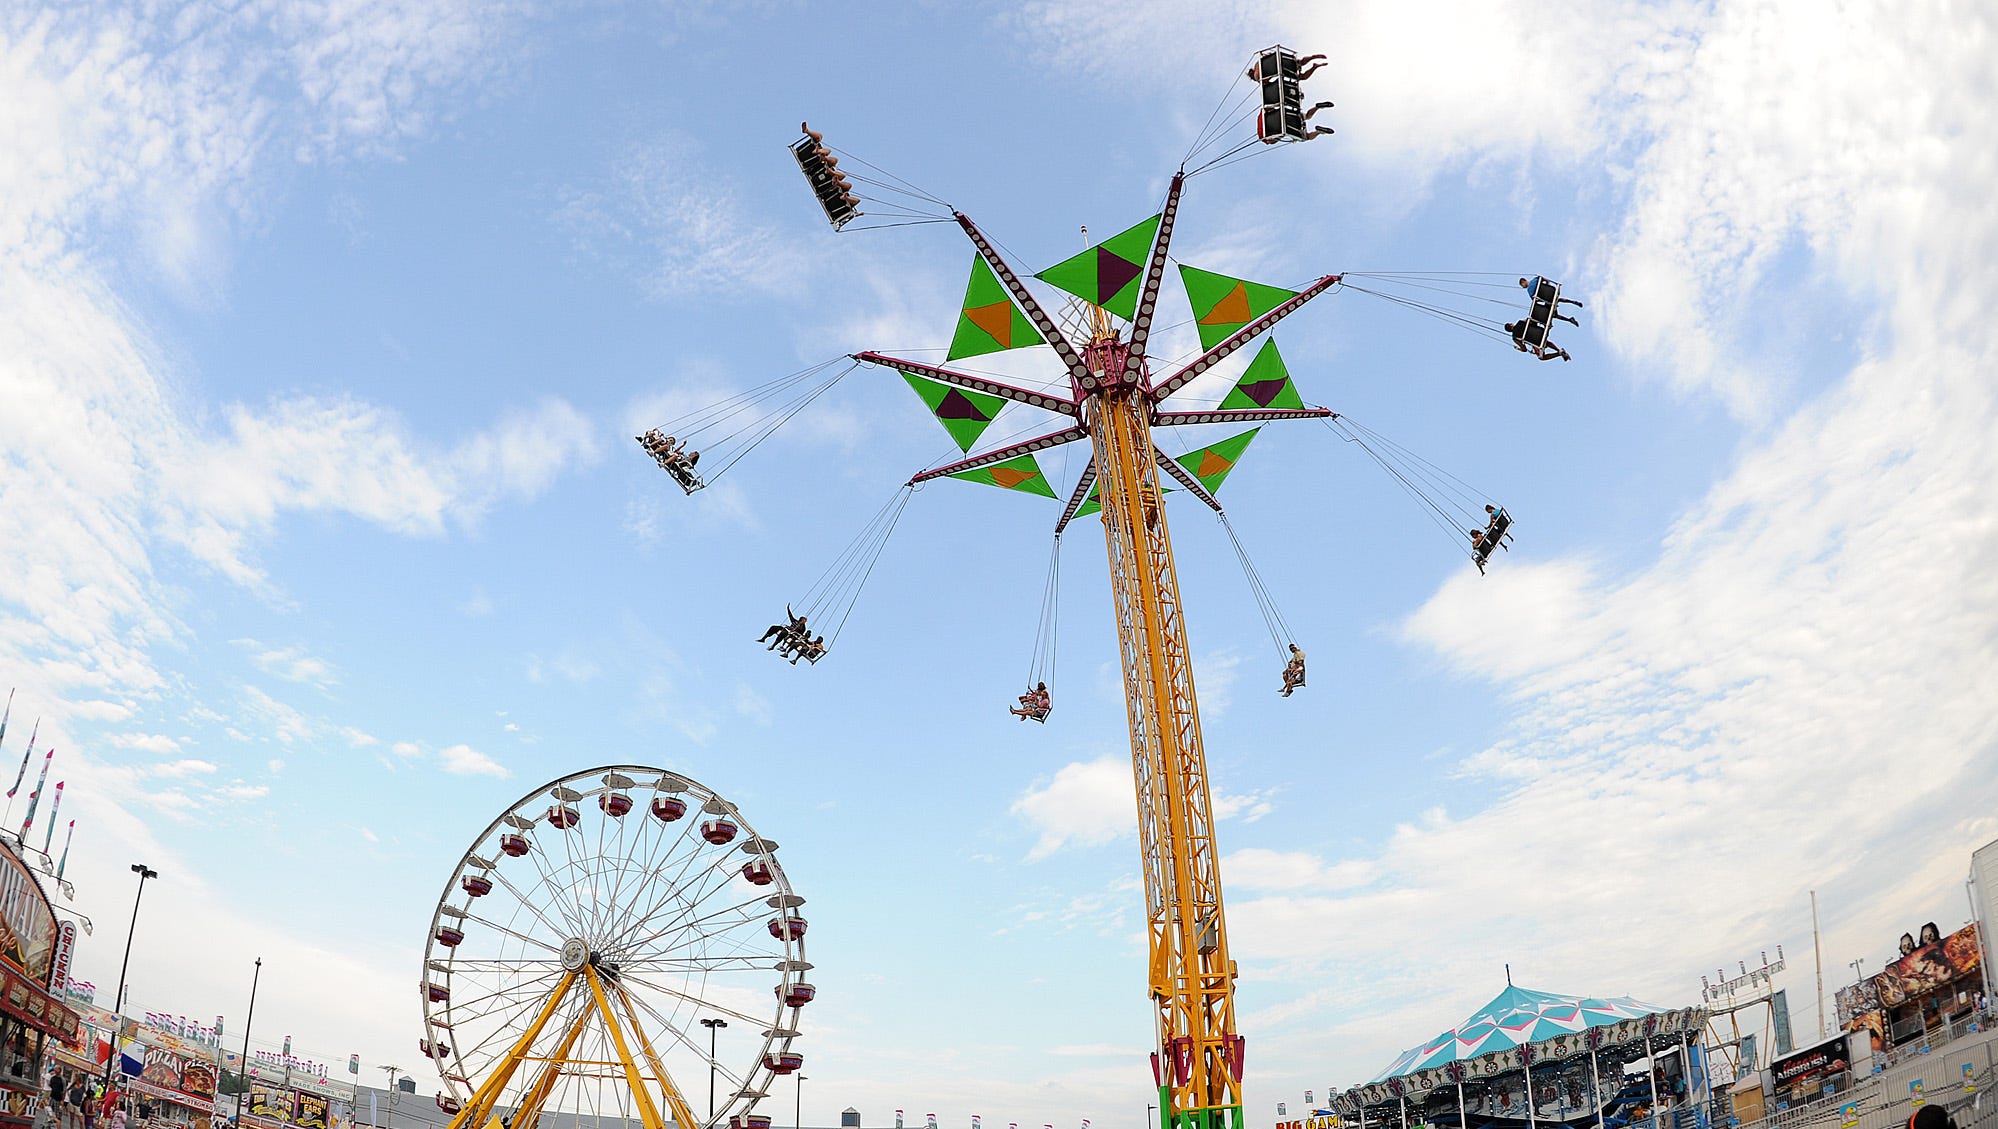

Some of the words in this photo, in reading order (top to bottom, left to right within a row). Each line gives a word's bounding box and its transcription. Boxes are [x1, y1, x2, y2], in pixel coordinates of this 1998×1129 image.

[54, 926, 74, 990] CHICKEN
[1777, 1055, 1828, 1080] AIRBRUSH
[300, 1094, 328, 1110] ELEPHANT
[303, 1103, 322, 1116] EARS
[1306, 1115, 1343, 1129] GAM
